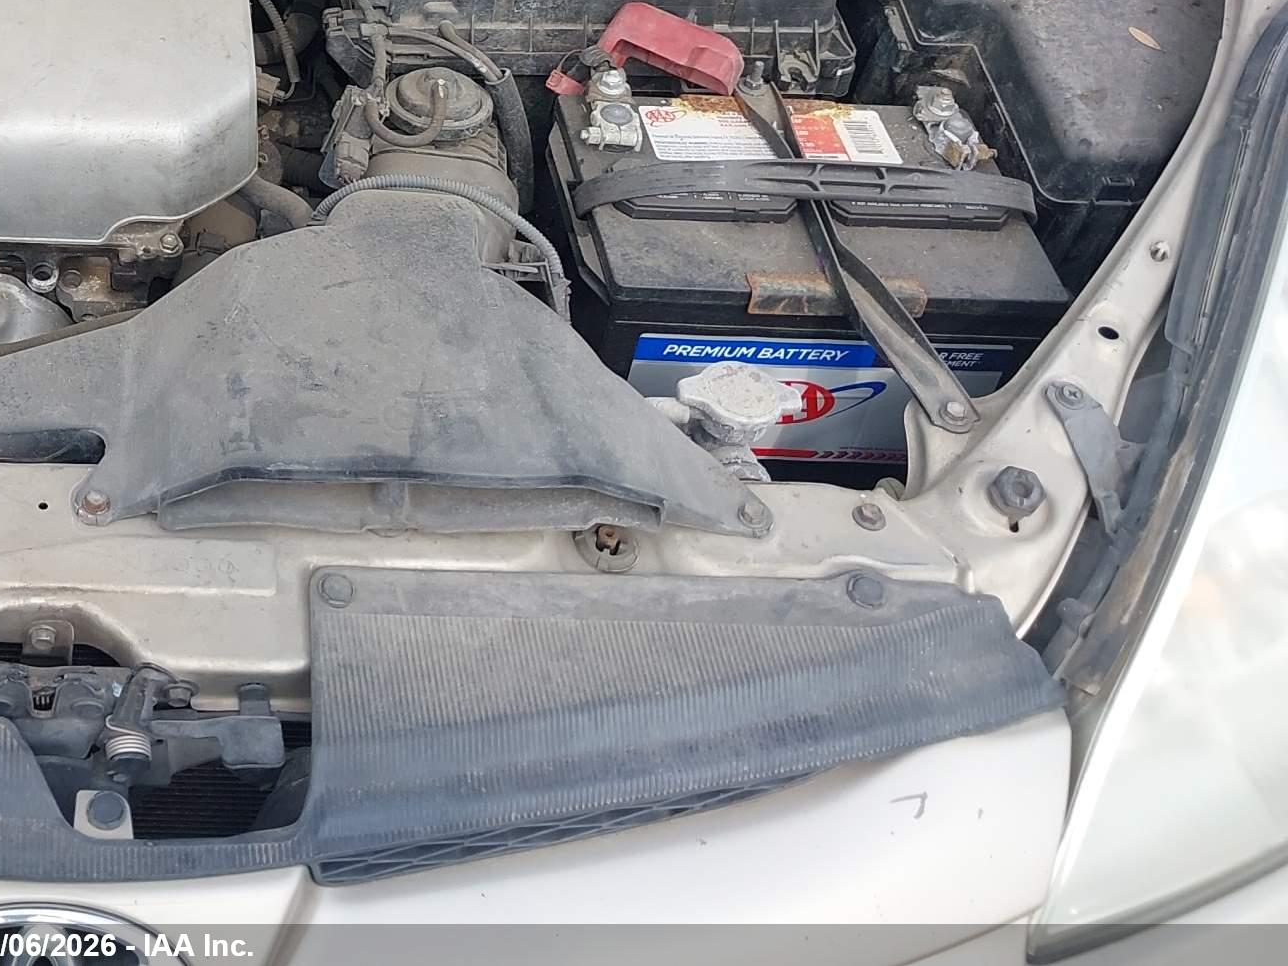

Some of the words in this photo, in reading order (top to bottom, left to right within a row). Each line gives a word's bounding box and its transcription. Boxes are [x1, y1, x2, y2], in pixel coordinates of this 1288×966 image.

[662, 343, 758, 359] PREMIUM
[756, 346, 850, 362] BATTERY
[948, 352, 984, 361] FREE
